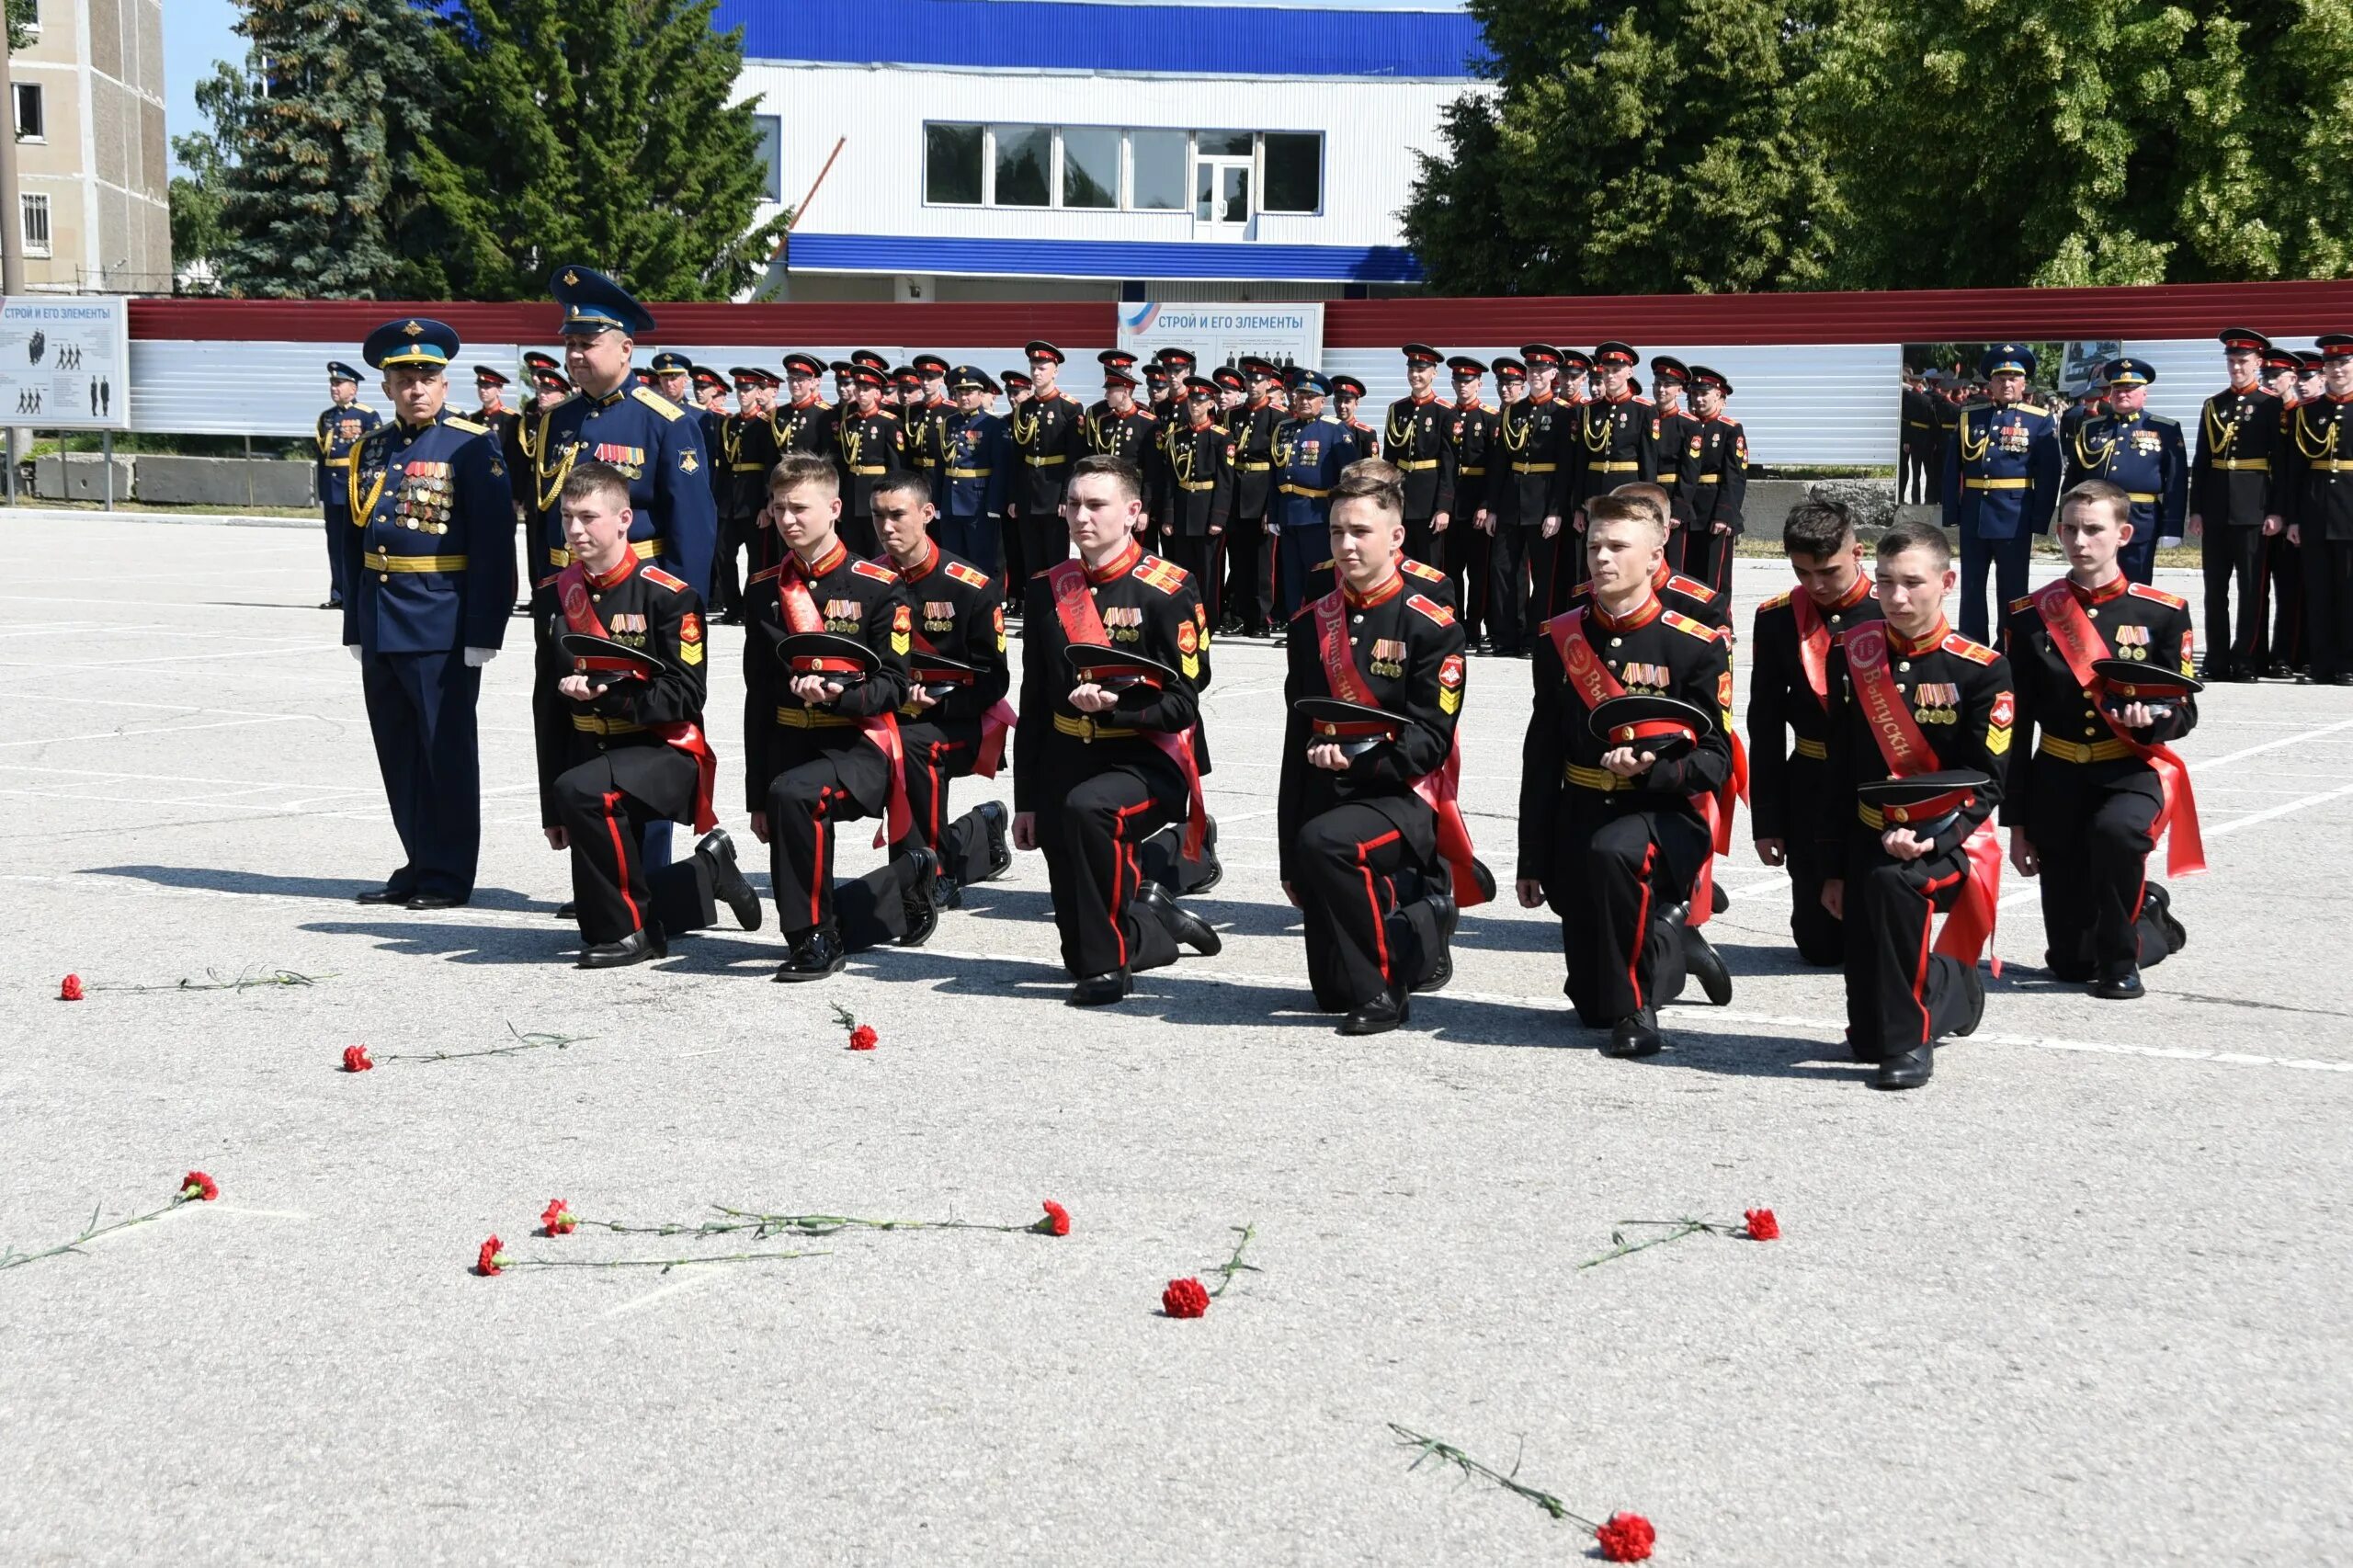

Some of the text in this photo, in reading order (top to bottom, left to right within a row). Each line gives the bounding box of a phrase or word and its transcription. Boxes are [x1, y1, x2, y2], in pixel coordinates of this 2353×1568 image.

[5, 306, 110, 319] СТРОЙ И ЕГО ЭЛЕМЕНТЫ
[1158, 313, 1303, 329] СТРОЙ И ЕГО ЭЛЕМЕНТЫ
